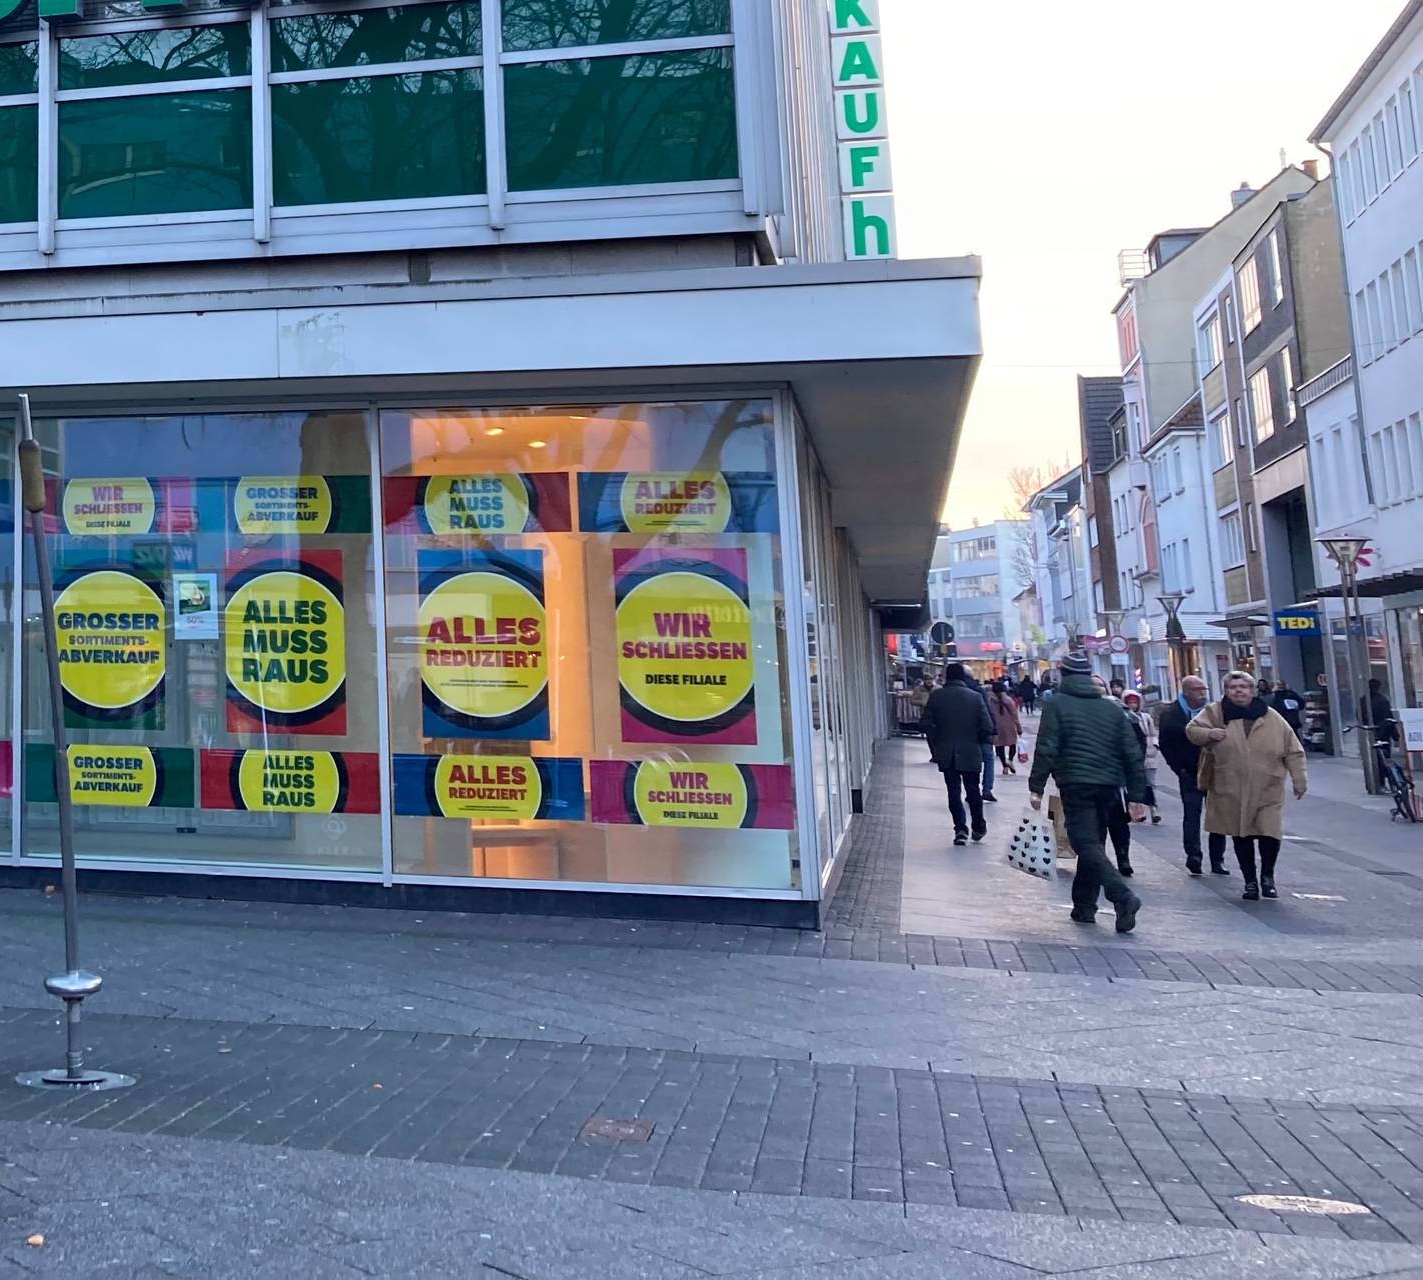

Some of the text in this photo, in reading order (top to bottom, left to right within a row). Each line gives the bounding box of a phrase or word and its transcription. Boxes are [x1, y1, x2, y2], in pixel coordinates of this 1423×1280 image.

[92, 486, 124, 501] WIR
[246, 487, 318, 500] GROSSER
[449, 479, 503, 494] ALLES
[634, 480, 716, 499] ALLES
[74, 503, 143, 515] SCHLIESSEN
[449, 496, 504, 511] MUSS
[634, 503, 716, 515] REDUZIERT
[247, 511, 319, 522] ABVERKAUF
[449, 514, 505, 529] RAUS
[242, 600, 328, 625] ALLES
[57, 612, 159, 631] GROSSER
[653, 612, 713, 639] WIR
[1277, 616, 1315, 630] TEDi
[426, 616, 542, 646] ALLES
[68, 635, 149, 646] SORTIMENTS-
[242, 629, 328, 655] MUSS
[58, 649, 160, 665] ABVERKAUF
[622, 641, 748, 660] SCHLIESSEN
[425, 649, 542, 669] REDUZIERT
[242, 658, 329, 684] RAUS
[645, 673, 727, 686] DIESE FILIALE
[73, 755, 143, 770] GROSSER
[263, 755, 315, 771] ALLES
[263, 773, 315, 789] MUSS
[448, 764, 528, 785] ALLES
[669, 771, 709, 790] WIR
[74, 780, 144, 793] ABVERKAUF
[448, 787, 528, 801] REDUZIERT
[262, 791, 316, 808] RAUS
[647, 790, 733, 806] SCHLIESSEN
[663, 810, 720, 820] DIESE FILIALE
